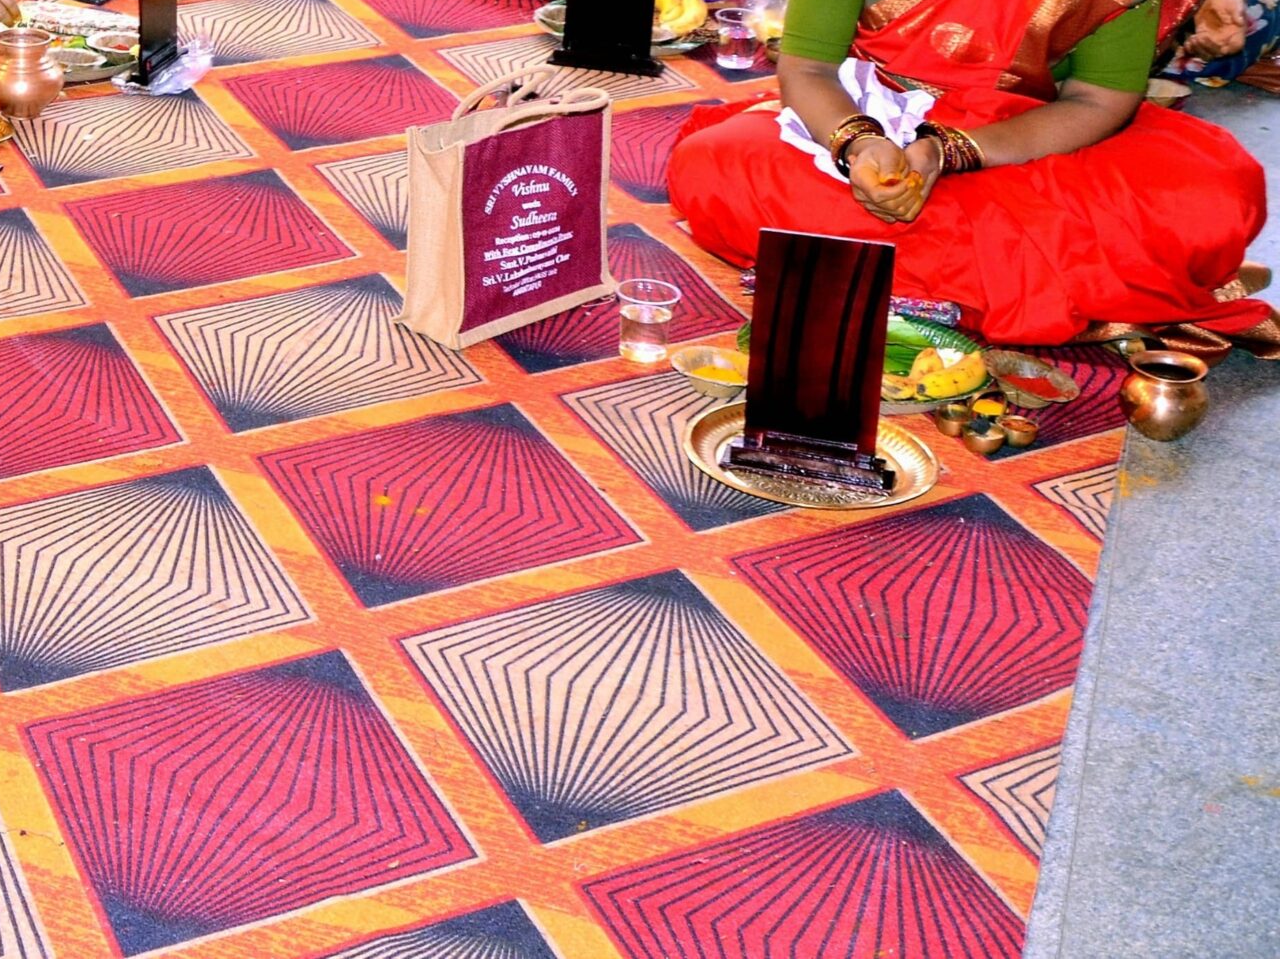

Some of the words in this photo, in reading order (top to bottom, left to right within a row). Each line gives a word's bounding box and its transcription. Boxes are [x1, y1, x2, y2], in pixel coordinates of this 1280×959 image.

[511, 179, 550, 197] Vishnu
[548, 167, 579, 197] FAMILY
[510, 210, 558, 230] Sudheera
[483, 250, 501, 261] With
[502, 247, 519, 257] Best
